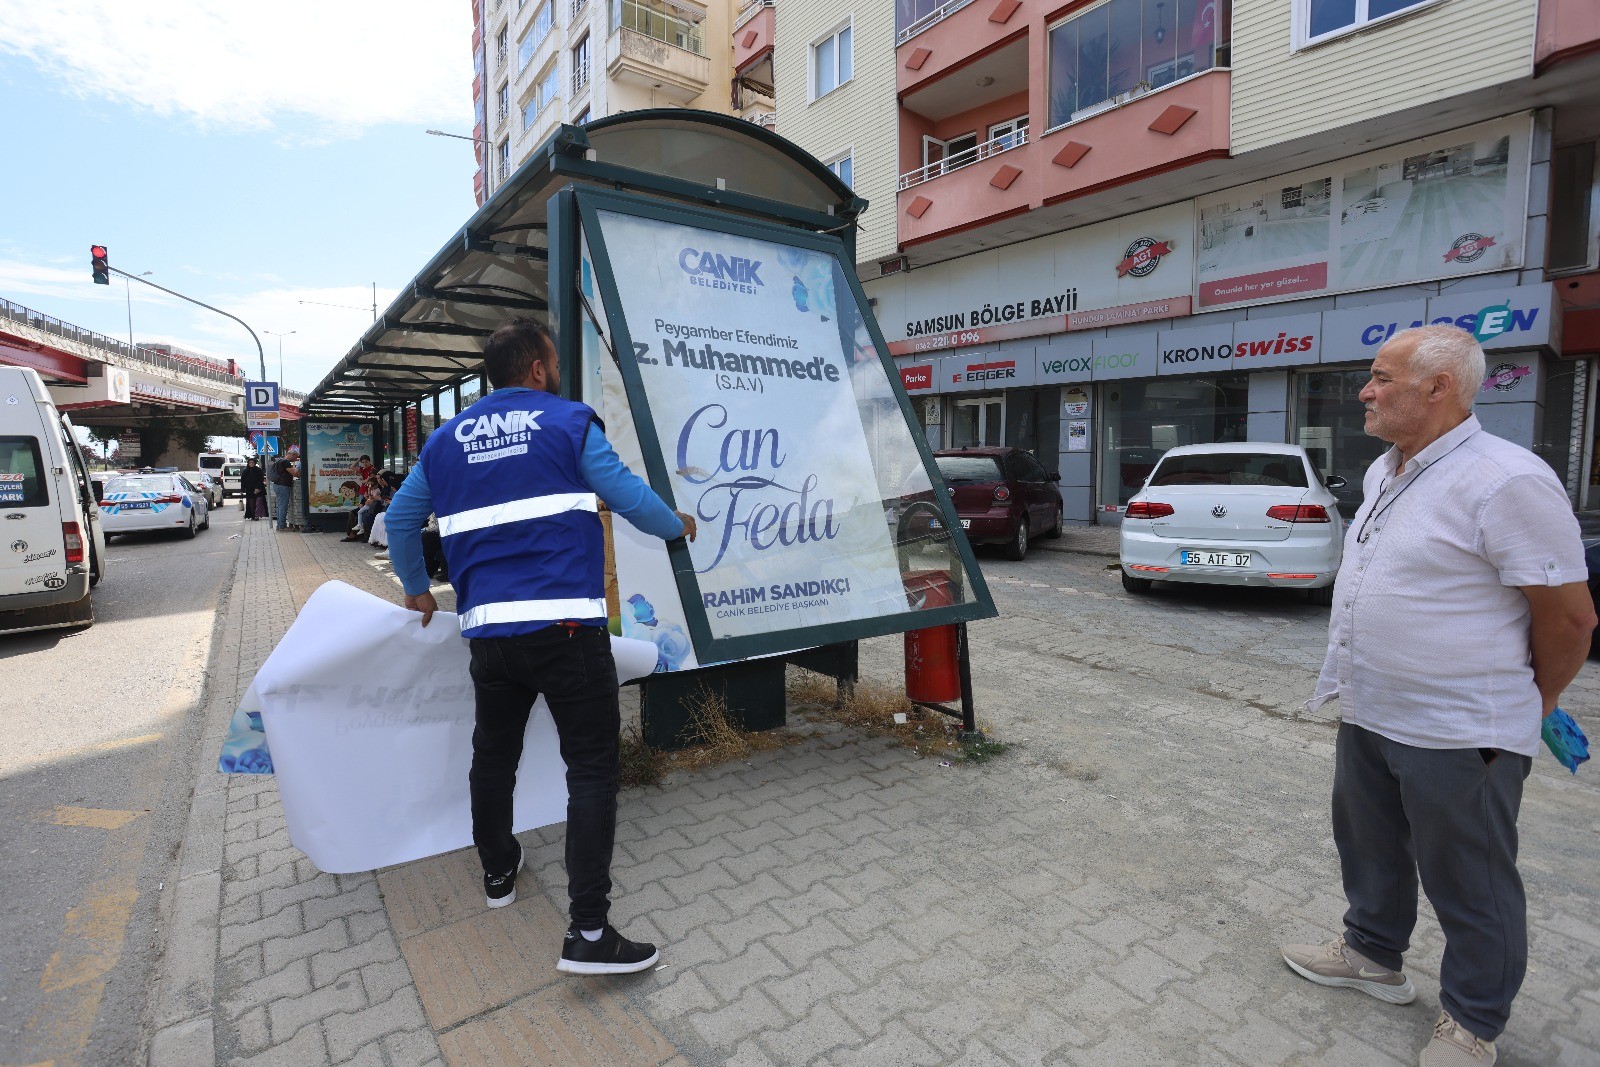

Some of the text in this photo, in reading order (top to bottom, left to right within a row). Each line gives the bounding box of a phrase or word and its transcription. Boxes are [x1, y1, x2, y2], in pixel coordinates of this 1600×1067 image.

[1133, 249, 1151, 265] AGT
[689, 275, 757, 295] BELEDİYESİ
[1214, 285, 1243, 296] Onunla
[1244, 283, 1258, 292] her
[1260, 282, 1275, 291] yer
[906, 312, 965, 337] SAMSUN
[970, 302, 1025, 327] BÖLGE
[1143, 304, 1170, 315] PARKE
[655, 318, 799, 349] Peygamber Efendimiz
[961, 331, 980, 344] 996
[663, 338, 840, 383] Muhammed'e
[714, 373, 764, 394] (S.A.V)
[905, 374, 927, 384] Parke
[966, 368, 1016, 382] EGGER
[1496, 372, 1515, 383] AGT
[255, 388, 270, 405] D
[463, 431, 532, 453] BELEDİYESİ
[676, 403, 786, 484] Can
[695, 474, 841, 574] Feda
[1187, 552, 1250, 566] 55 ATF 07
[770, 577, 851, 601] SANDIKÇI
[716, 598, 829, 619] CANİK BELEDİYE BAŞKANI
